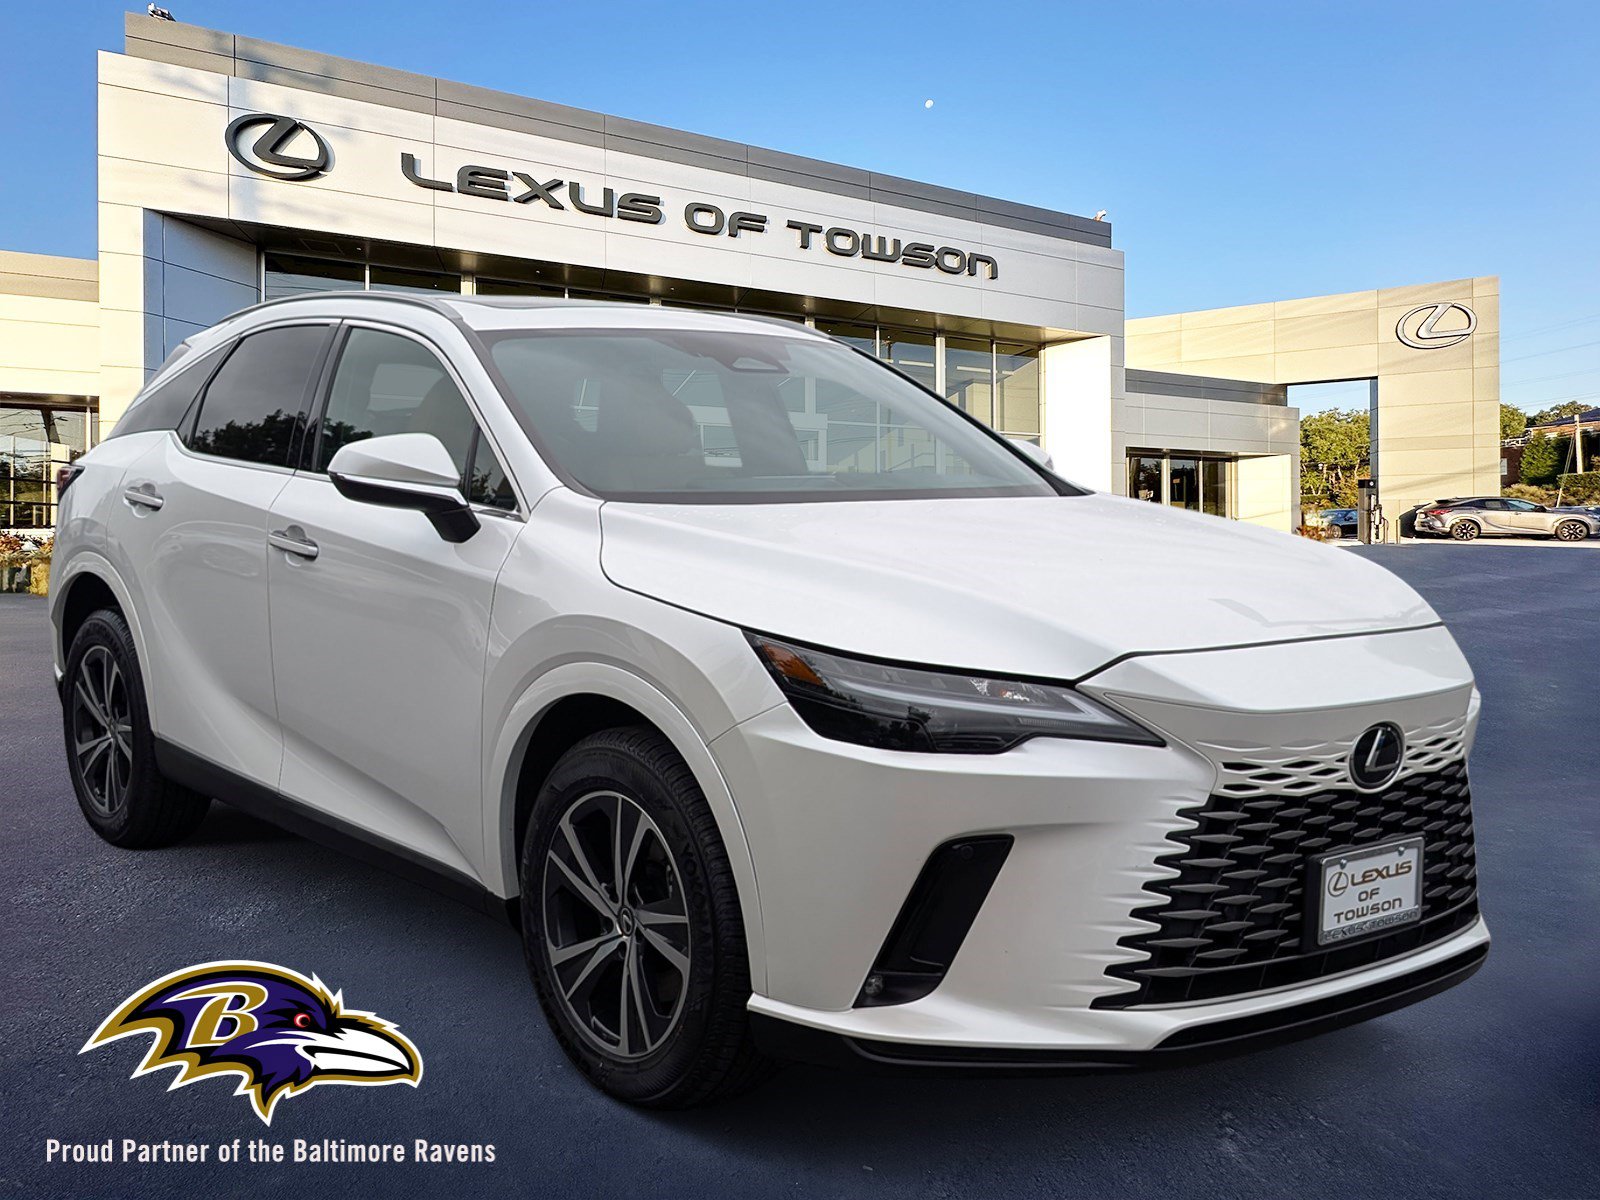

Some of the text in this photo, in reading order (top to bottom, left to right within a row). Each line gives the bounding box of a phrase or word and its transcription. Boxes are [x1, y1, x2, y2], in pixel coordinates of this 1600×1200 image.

[401, 152, 998, 280] LEXUS OF TOWSON
[1350, 860, 1412, 886] LEXUS
[1358, 887, 1380, 902] OF
[1334, 897, 1402, 923] TOWSON
